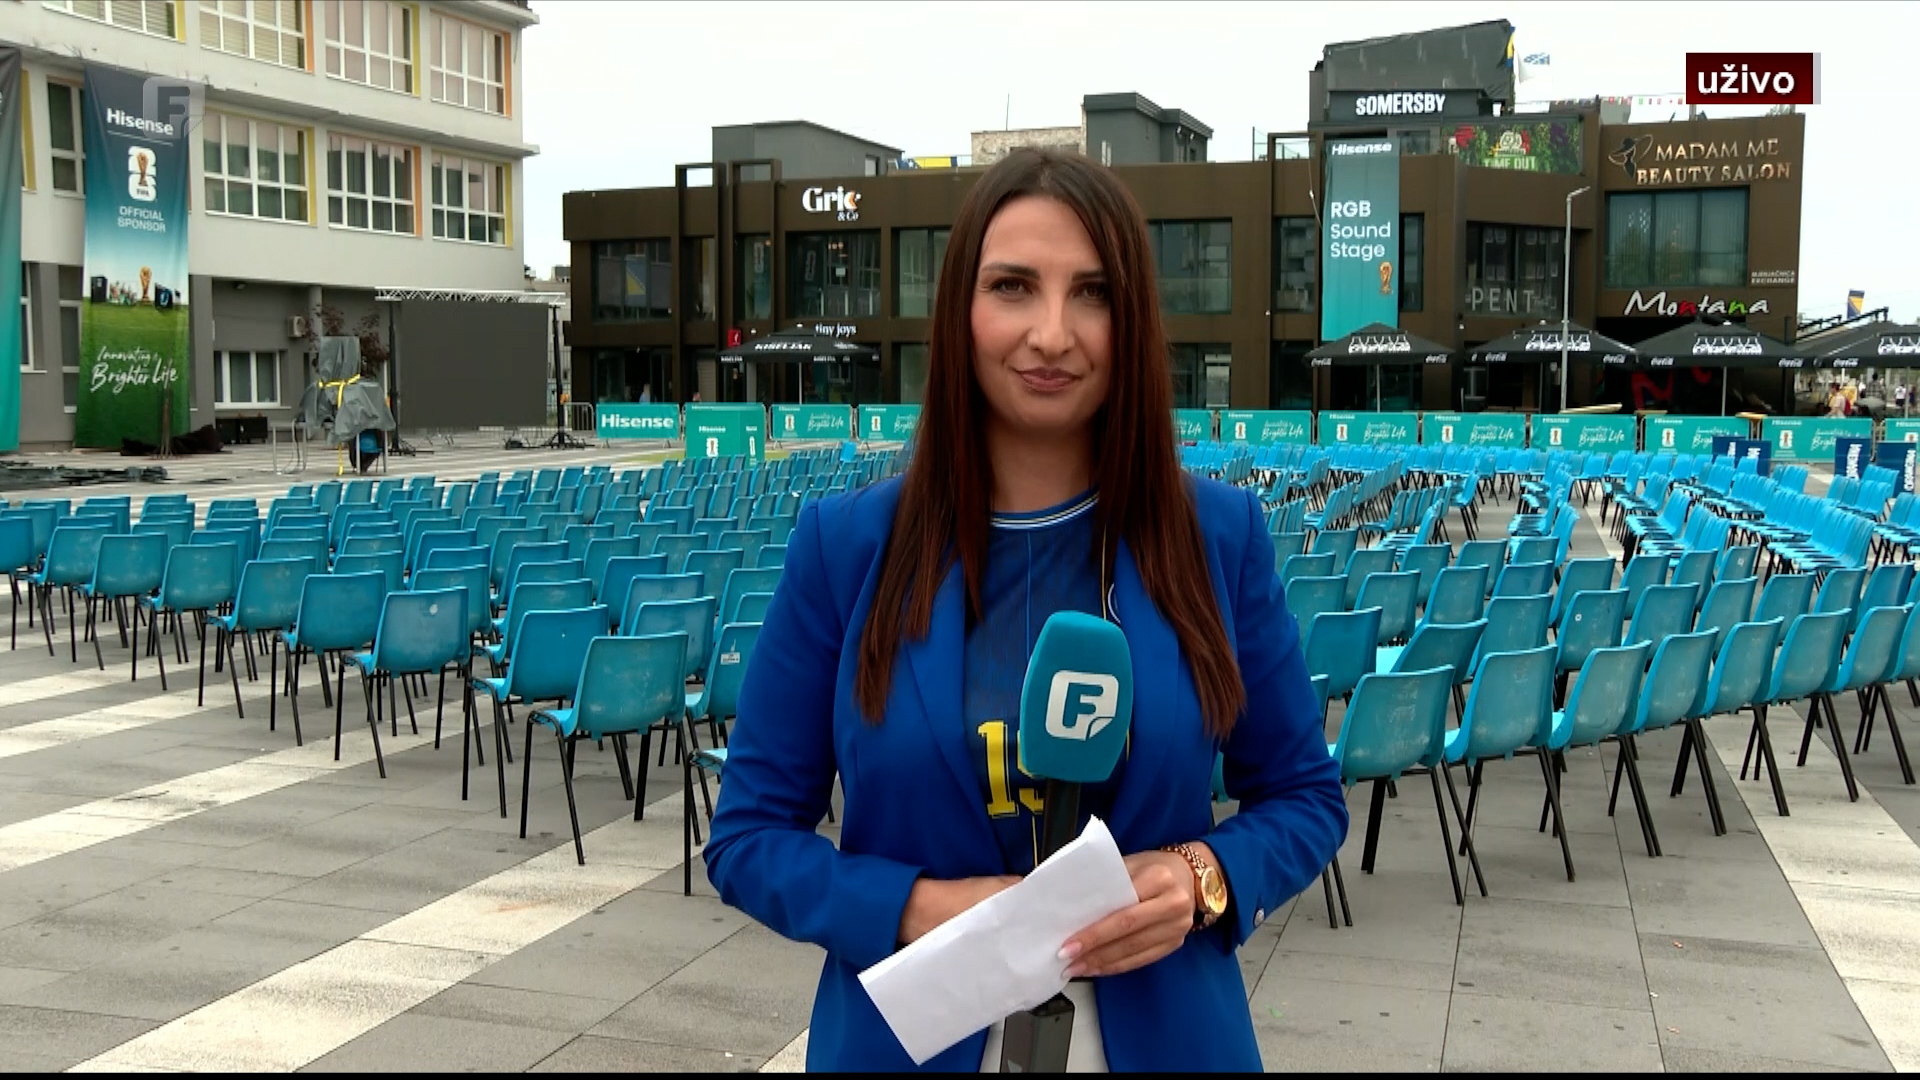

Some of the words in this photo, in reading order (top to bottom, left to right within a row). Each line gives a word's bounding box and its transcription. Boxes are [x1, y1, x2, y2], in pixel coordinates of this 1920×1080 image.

[1355, 92, 1446, 116] SOMERSBY
[106, 107, 174, 135] Hisense
[1331, 142, 1393, 156] Hisense
[1655, 141, 1739, 162] MADAM
[1746, 138, 1779, 158] ME
[1636, 166, 1715, 186] BEAUTY
[1720, 162, 1792, 183] SALON
[119, 205, 165, 222] OFFICIAL
[1330, 200, 1372, 218] RGB
[117, 216, 166, 233] SPONSOR
[1330, 221, 1391, 239] Sound
[1330, 242, 1386, 261] Stage
[1624, 290, 1770, 316] Montana
[815, 323, 836, 337] tiny
[835, 322, 857, 339] joys
[90, 361, 150, 395] Brighter
[152, 358, 179, 390] Life
[601, 414, 674, 428] Hisense
[978, 720, 1044, 819] 1
